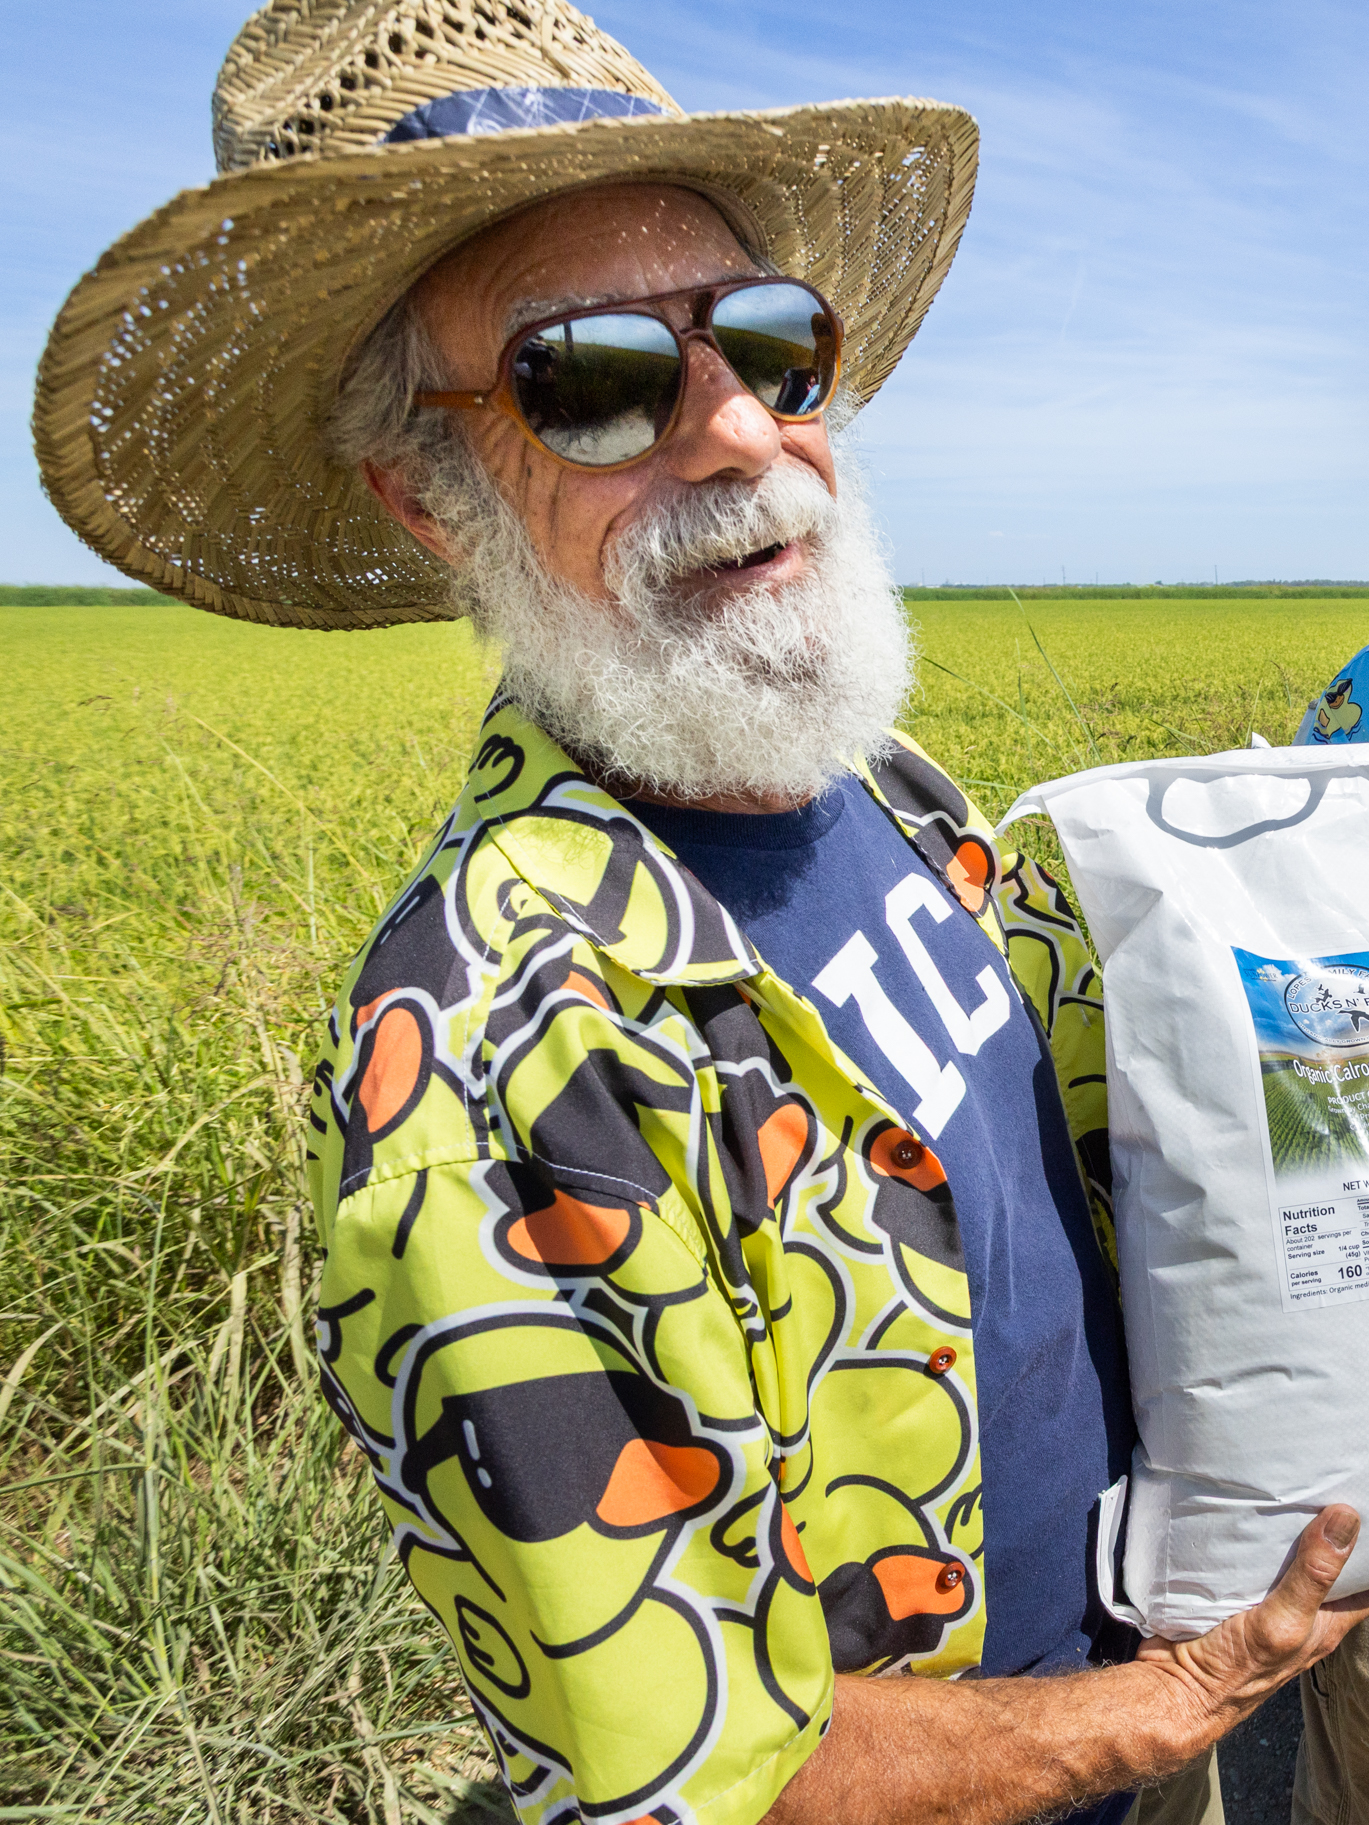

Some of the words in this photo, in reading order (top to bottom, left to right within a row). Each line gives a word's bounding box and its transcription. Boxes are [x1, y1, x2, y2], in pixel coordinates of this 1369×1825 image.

[1287, 976, 1312, 999] LOPES
[811, 872, 1011, 1141] IC
[1289, 999, 1342, 1013] DUCKS
[1346, 998, 1360, 1007] N'
[1292, 1059, 1333, 1085] Organic
[1327, 1091, 1365, 1105] PRODUCT
[1343, 1181, 1362, 1192] NET
[1283, 1206, 1336, 1222] Nutrition
[1284, 1223, 1318, 1236] Facts
[1286, 1237, 1303, 1245] About
[1303, 1235, 1315, 1243] 202
[1318, 1232, 1342, 1241] servings
[1287, 1243, 1313, 1252] container
[1345, 1250, 1361, 1259] (45g)
[1287, 1251, 1312, 1260] Serving
[1290, 1270, 1319, 1280] Calories
[1337, 1264, 1363, 1280] 160
[1301, 1277, 1322, 1285] serving
[1290, 1288, 1329, 1300] Ingredients:
[1329, 1283, 1354, 1294] Organic
